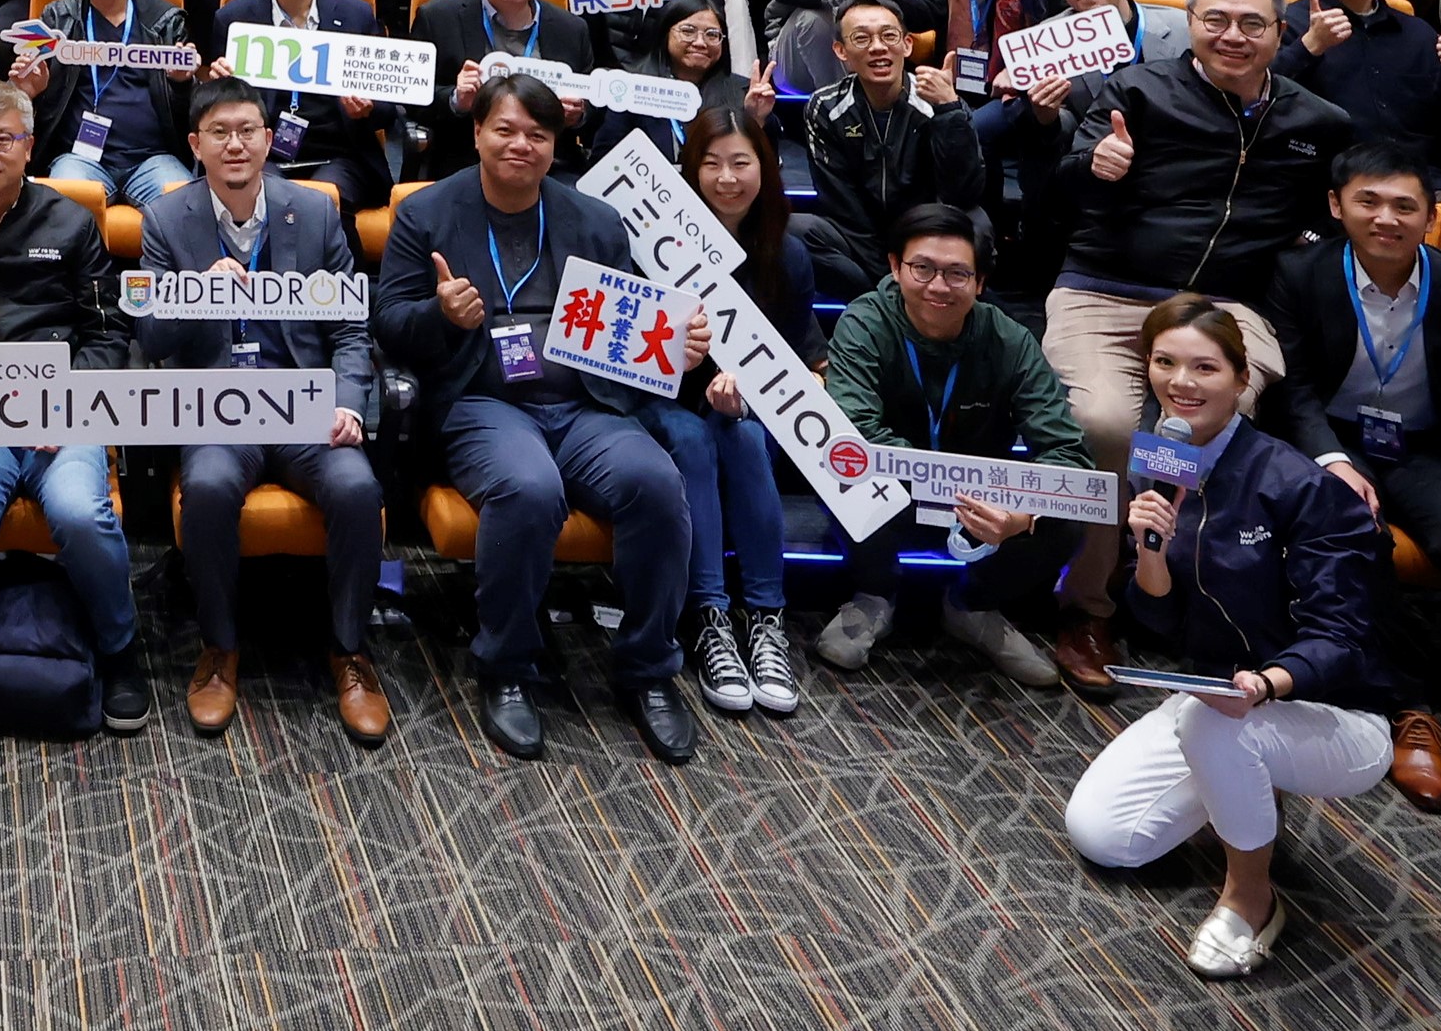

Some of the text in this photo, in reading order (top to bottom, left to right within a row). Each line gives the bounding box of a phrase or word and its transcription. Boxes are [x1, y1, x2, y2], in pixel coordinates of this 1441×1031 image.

[1005, 9, 1113, 63] HKUST
[60, 45, 194, 67] CUHK PI CENTRE
[343, 58, 410, 74] HONG KONG
[345, 45, 431, 65] 香港都會大學
[1013, 42, 1131, 86] Startups
[341, 79, 409, 95] UNIVERSITY
[342, 70, 429, 87] METROPOLITAN
[623, 149, 723, 265] HONG KONG
[161, 276, 365, 306] iDENDRON
[599, 272, 666, 303] HKUST
[180, 308, 237, 316] INNOVATION
[558, 287, 676, 375] 科 大
[601, 165, 889, 502] TECHATHO+
[606, 295, 642, 365] 創業家
[549, 347, 674, 392] ENTREPRENEURSHIP CENTER
[875, 451, 983, 485] Lingnan
[987, 465, 1108, 498] 嶺南大學
[930, 481, 1025, 510] University
[1027, 497, 1108, 519] 香港 Hong Kong
[1148, 534, 1156, 543] 6
